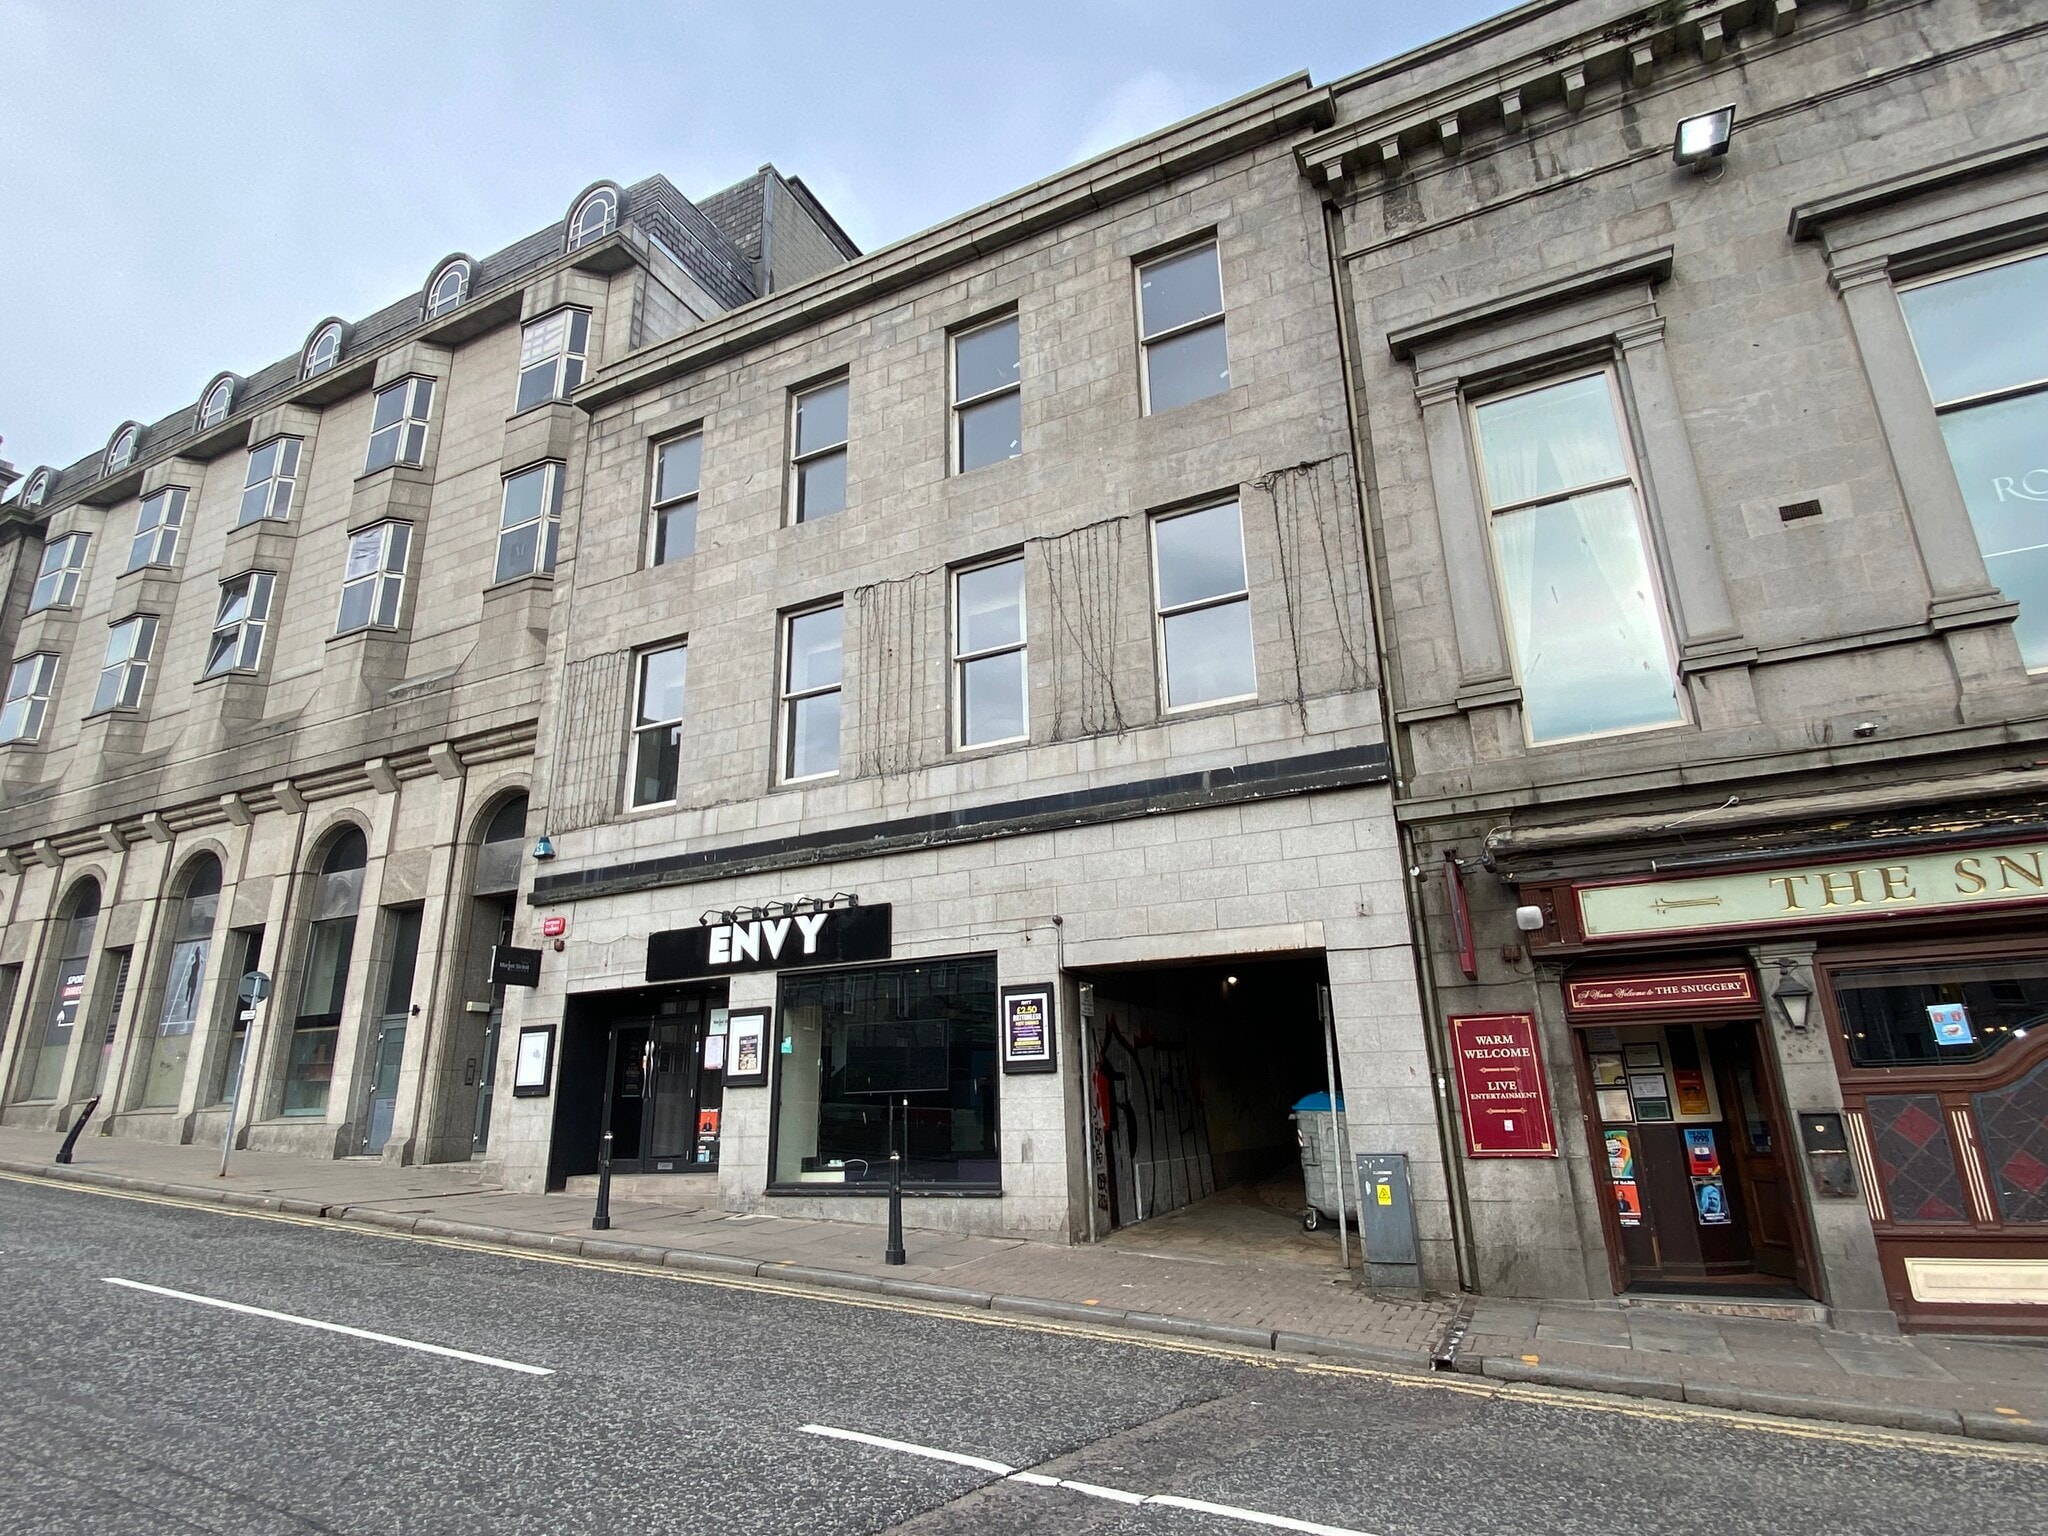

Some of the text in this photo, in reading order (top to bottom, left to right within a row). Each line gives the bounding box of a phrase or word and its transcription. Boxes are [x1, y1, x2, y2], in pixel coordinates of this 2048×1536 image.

[1768, 851, 2044, 912] THE SN
[708, 913, 829, 965] ENVY
[1614, 986, 1646, 999] Welcome
[1655, 986, 1679, 995] THE
[1681, 982, 1742, 994] SNUGGERY
[1016, 1005, 1038, 1014] £2.50
[1475, 1035, 1514, 1045] WARM
[1464, 1048, 1531, 1059] WELCOME
[1487, 1081, 1518, 1091] LIVE
[1470, 1092, 1538, 1100] ENTERTAINMENT
